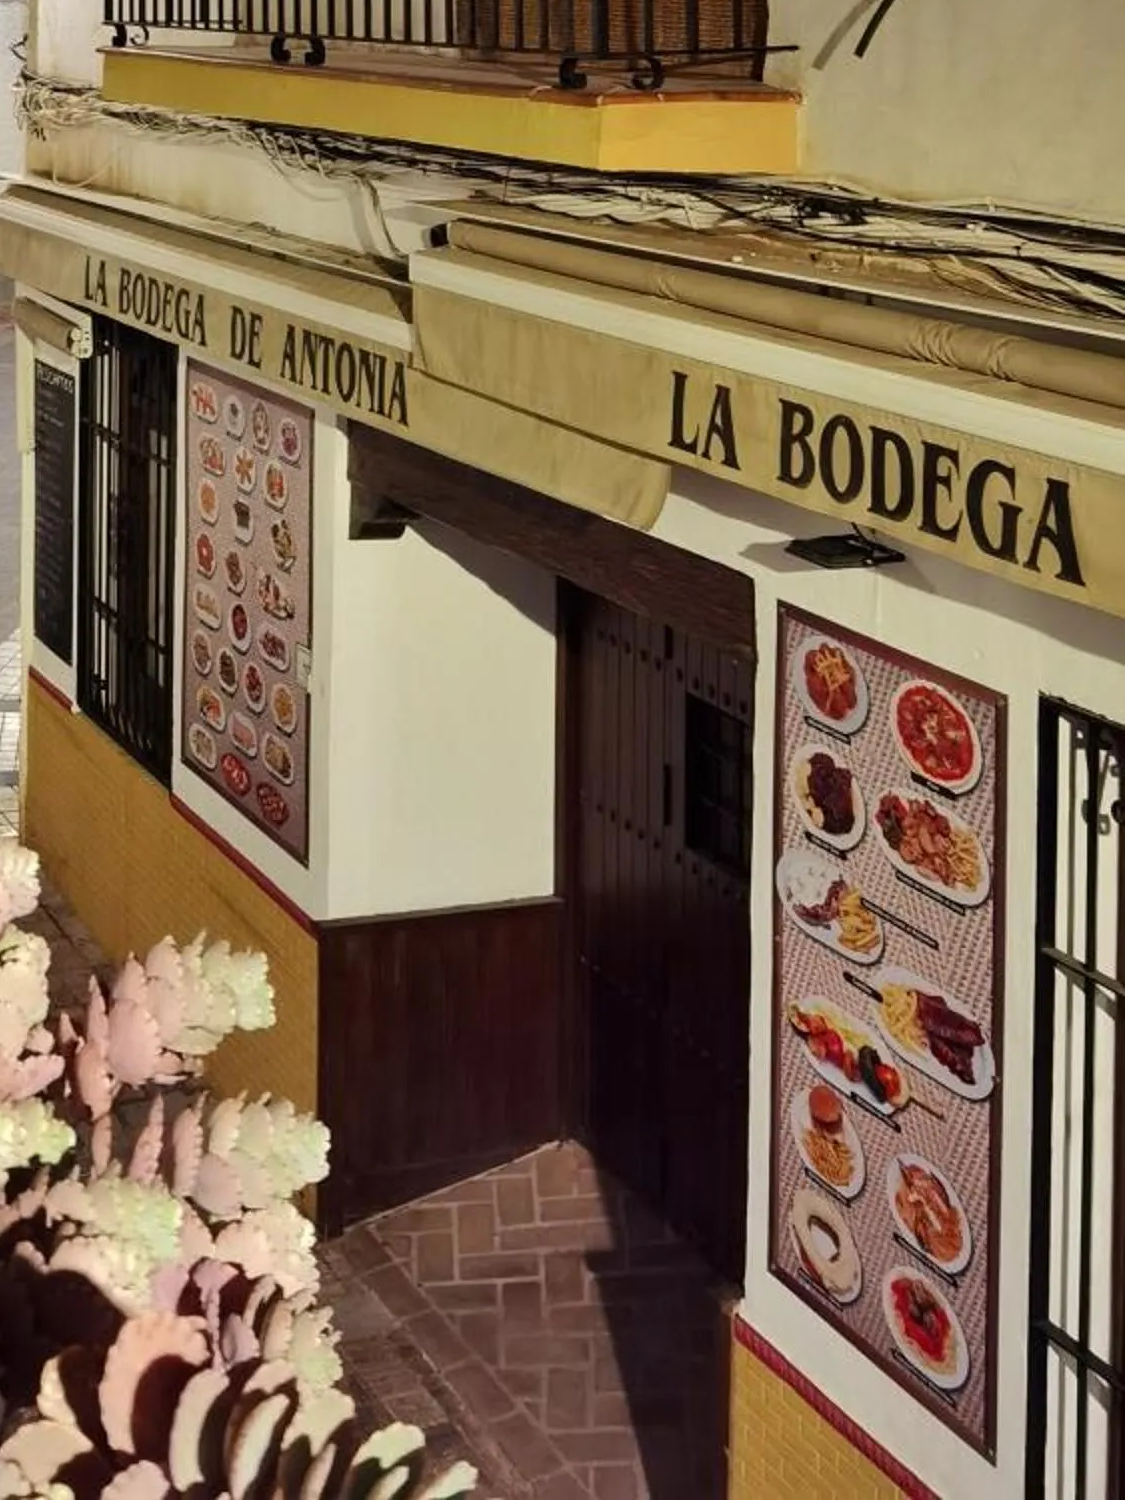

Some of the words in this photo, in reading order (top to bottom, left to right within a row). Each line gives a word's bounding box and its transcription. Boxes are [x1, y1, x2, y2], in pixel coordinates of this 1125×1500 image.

[84, 255, 108, 307] LA
[119, 267, 207, 347] BODEGA
[230, 305, 263, 369] DE
[279, 324, 409, 428] ANTONIA
[667, 371, 741, 471] LA
[777, 398, 1086, 588] BODEGA
